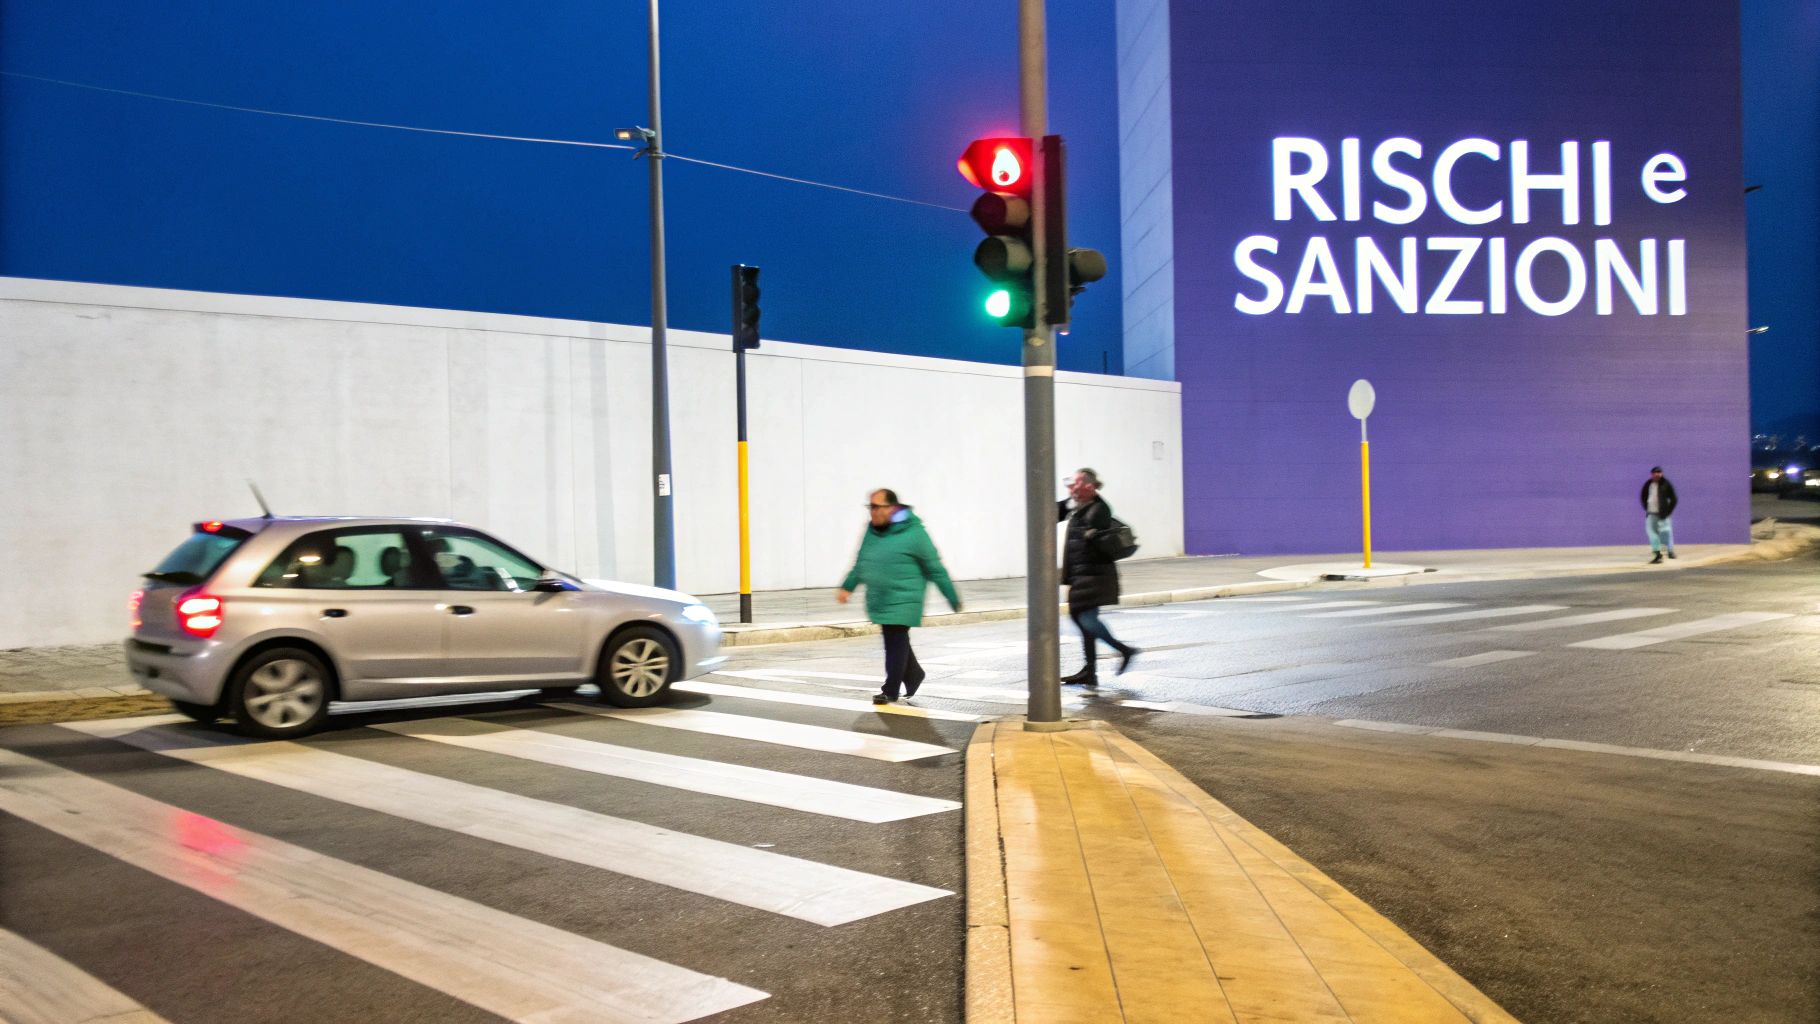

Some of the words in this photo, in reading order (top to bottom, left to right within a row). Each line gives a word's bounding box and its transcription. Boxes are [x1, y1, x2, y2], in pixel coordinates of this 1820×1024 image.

[1272, 136, 1611, 225] RISCHI
[1642, 153, 1687, 204] e
[1234, 235, 1687, 316] SANZIONI
